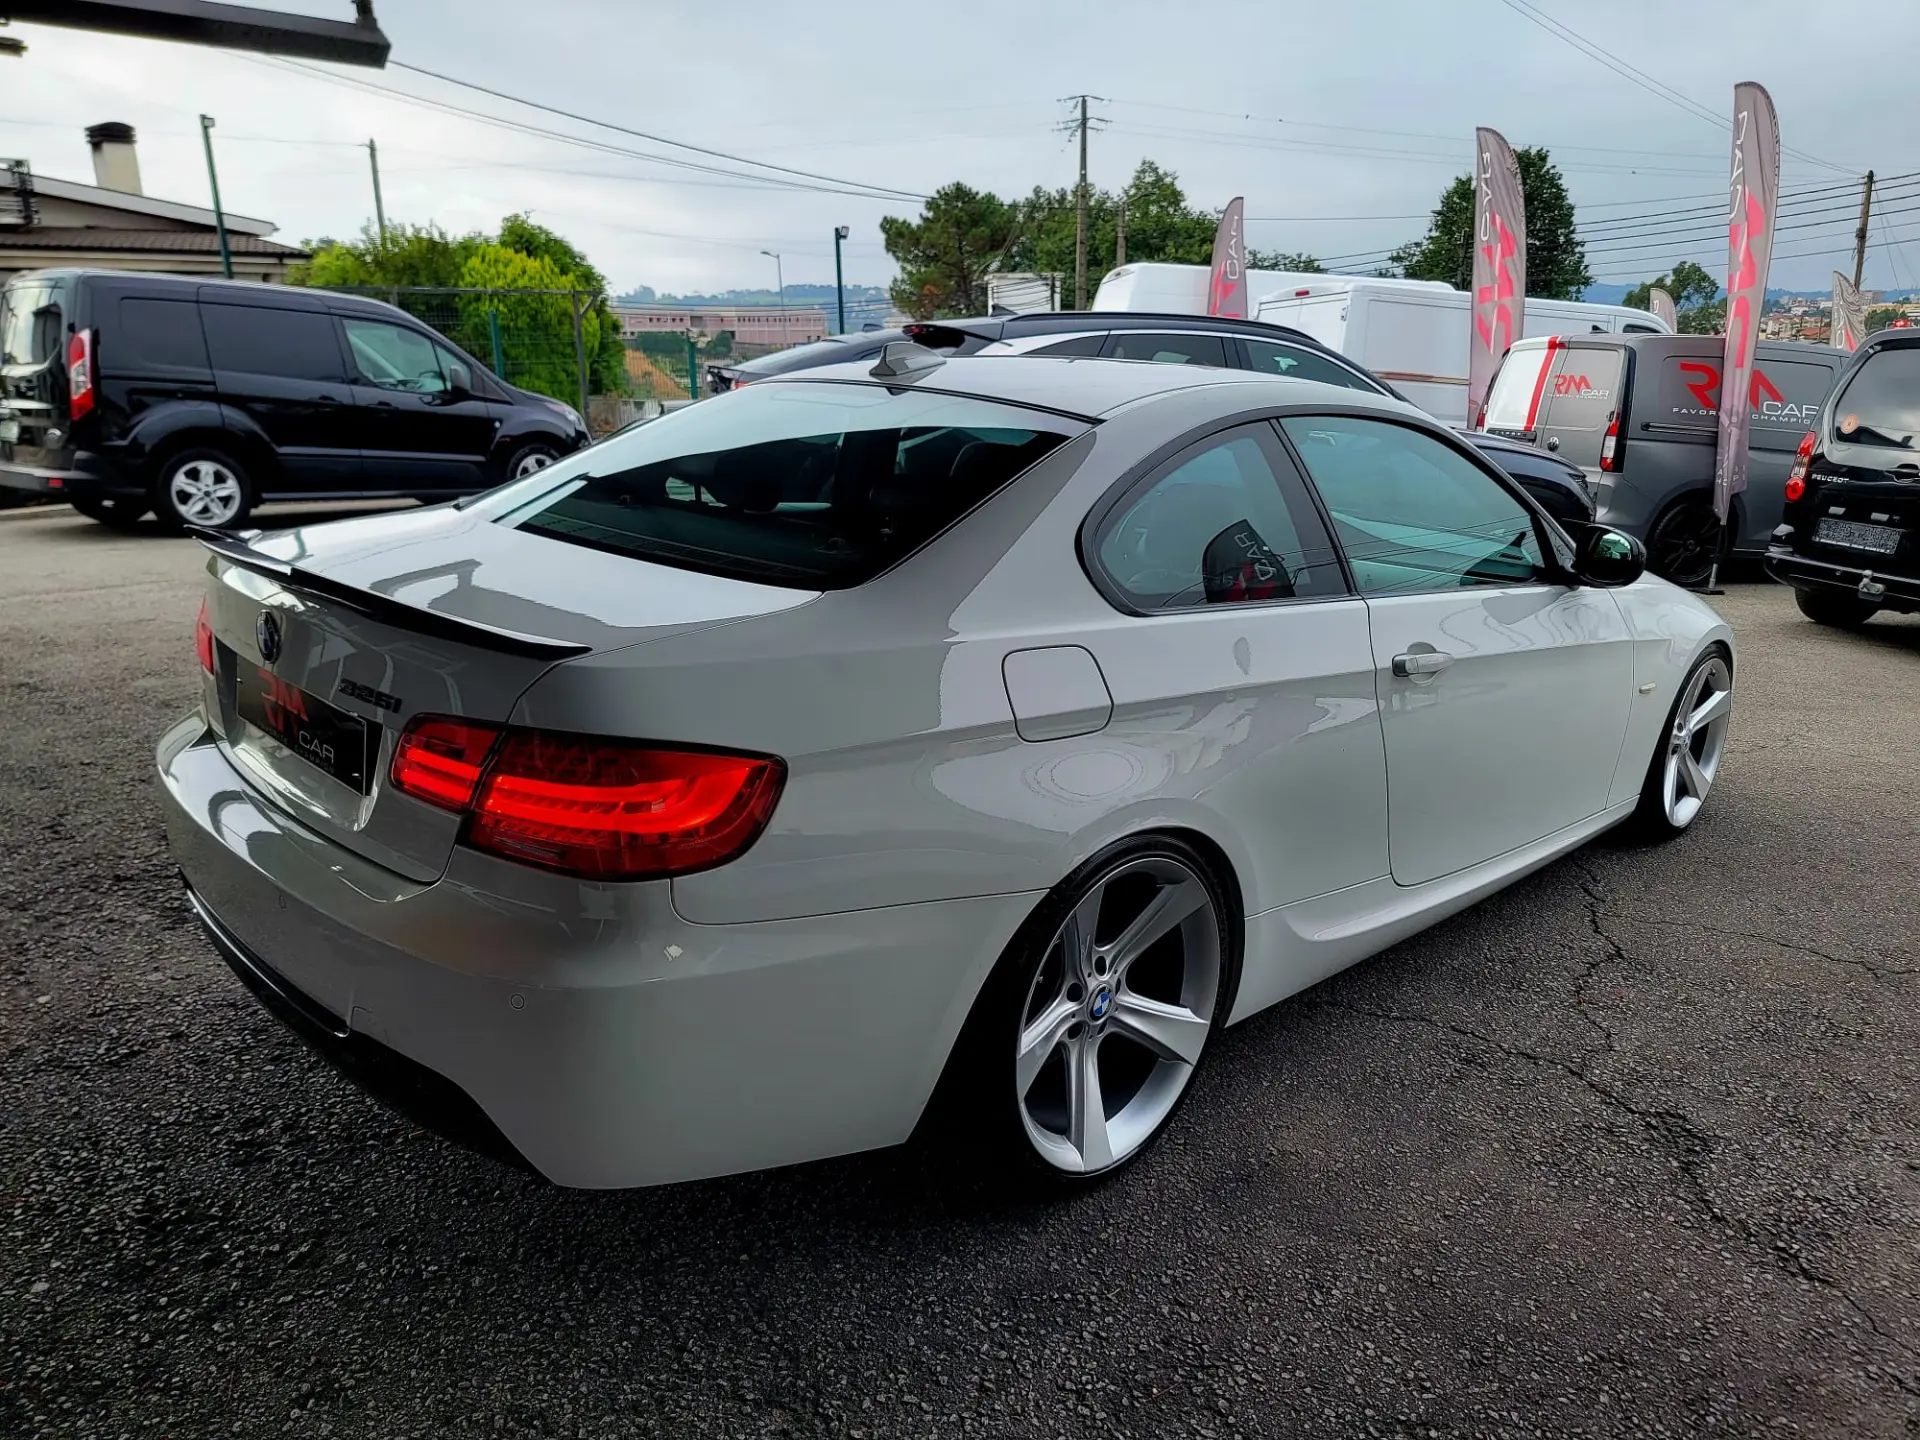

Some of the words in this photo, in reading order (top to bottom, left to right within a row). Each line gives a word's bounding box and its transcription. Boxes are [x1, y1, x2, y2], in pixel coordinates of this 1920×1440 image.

[1554, 374, 1592, 394] RM
[1581, 389, 1609, 397] CAR
[1811, 473, 1850, 484] PEUGEOT
[298, 730, 335, 764] CAR
